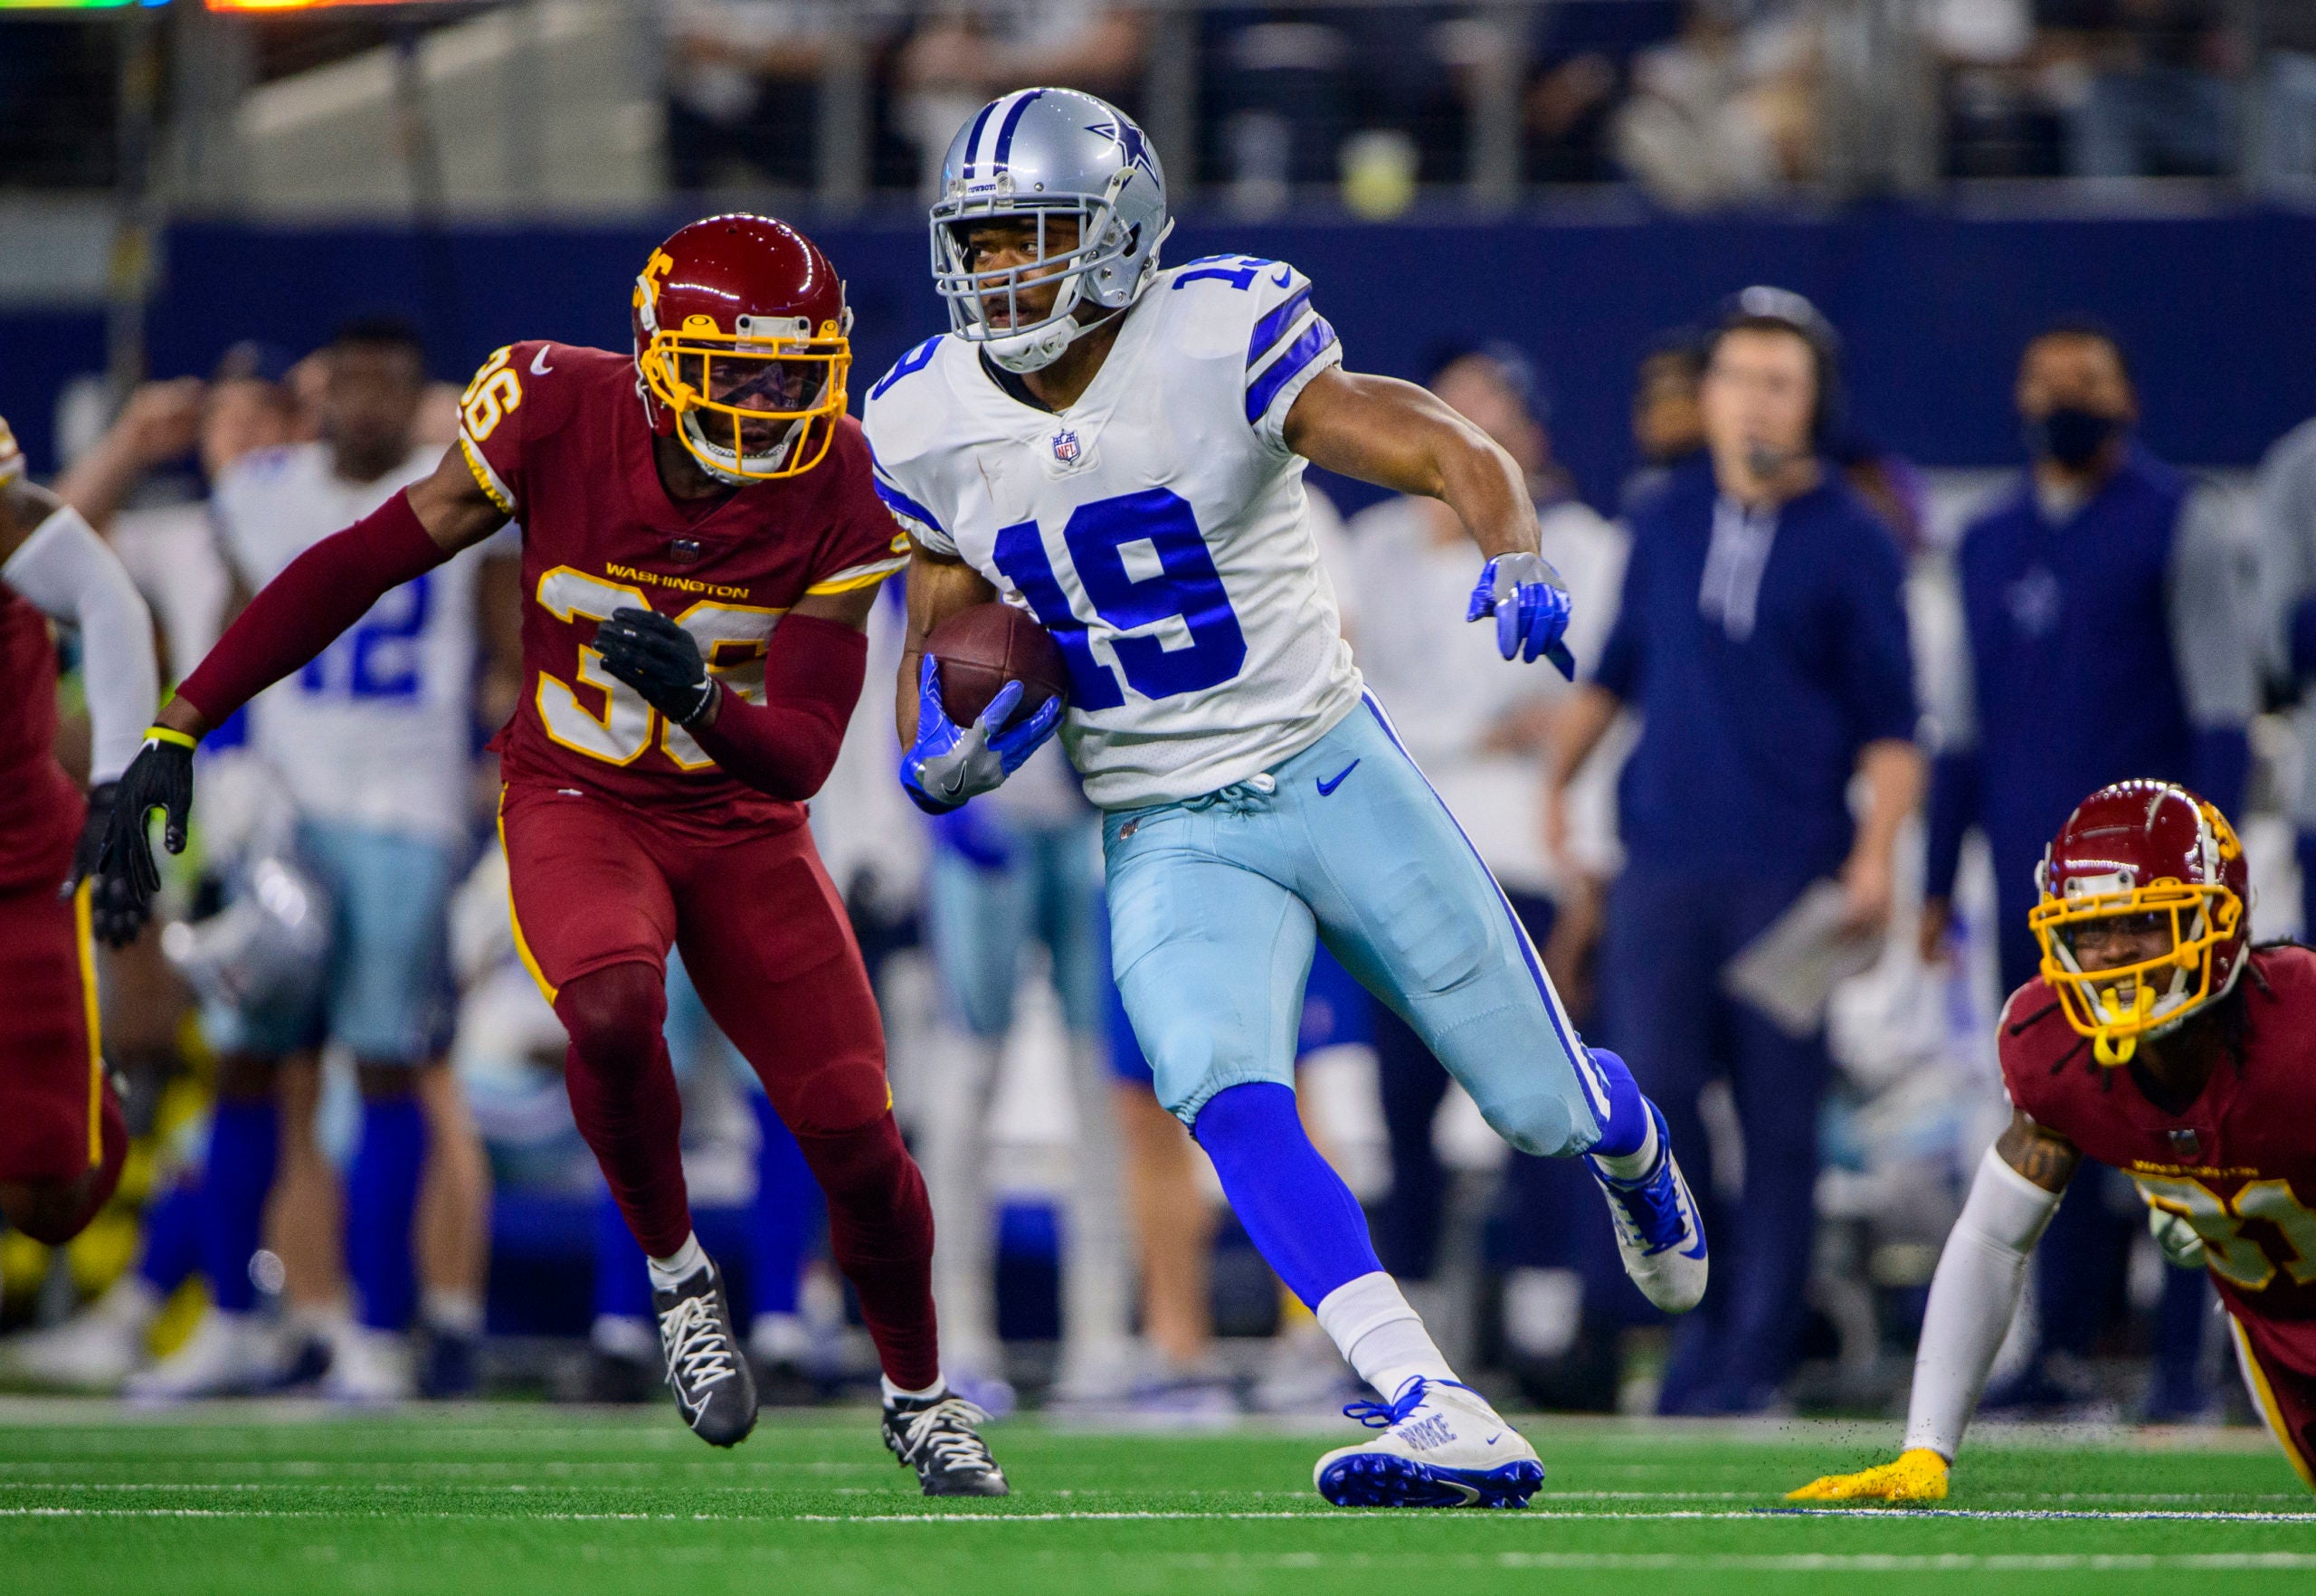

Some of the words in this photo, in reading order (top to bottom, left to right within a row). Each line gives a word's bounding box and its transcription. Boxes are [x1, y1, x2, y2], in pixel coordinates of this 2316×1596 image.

[1057, 442, 1077, 459] NFL
[605, 561, 749, 599] WASHINGTON
[992, 486, 1248, 713] 19
[300, 570, 428, 696] 2
[1397, 1412, 1457, 1451] NIKE
